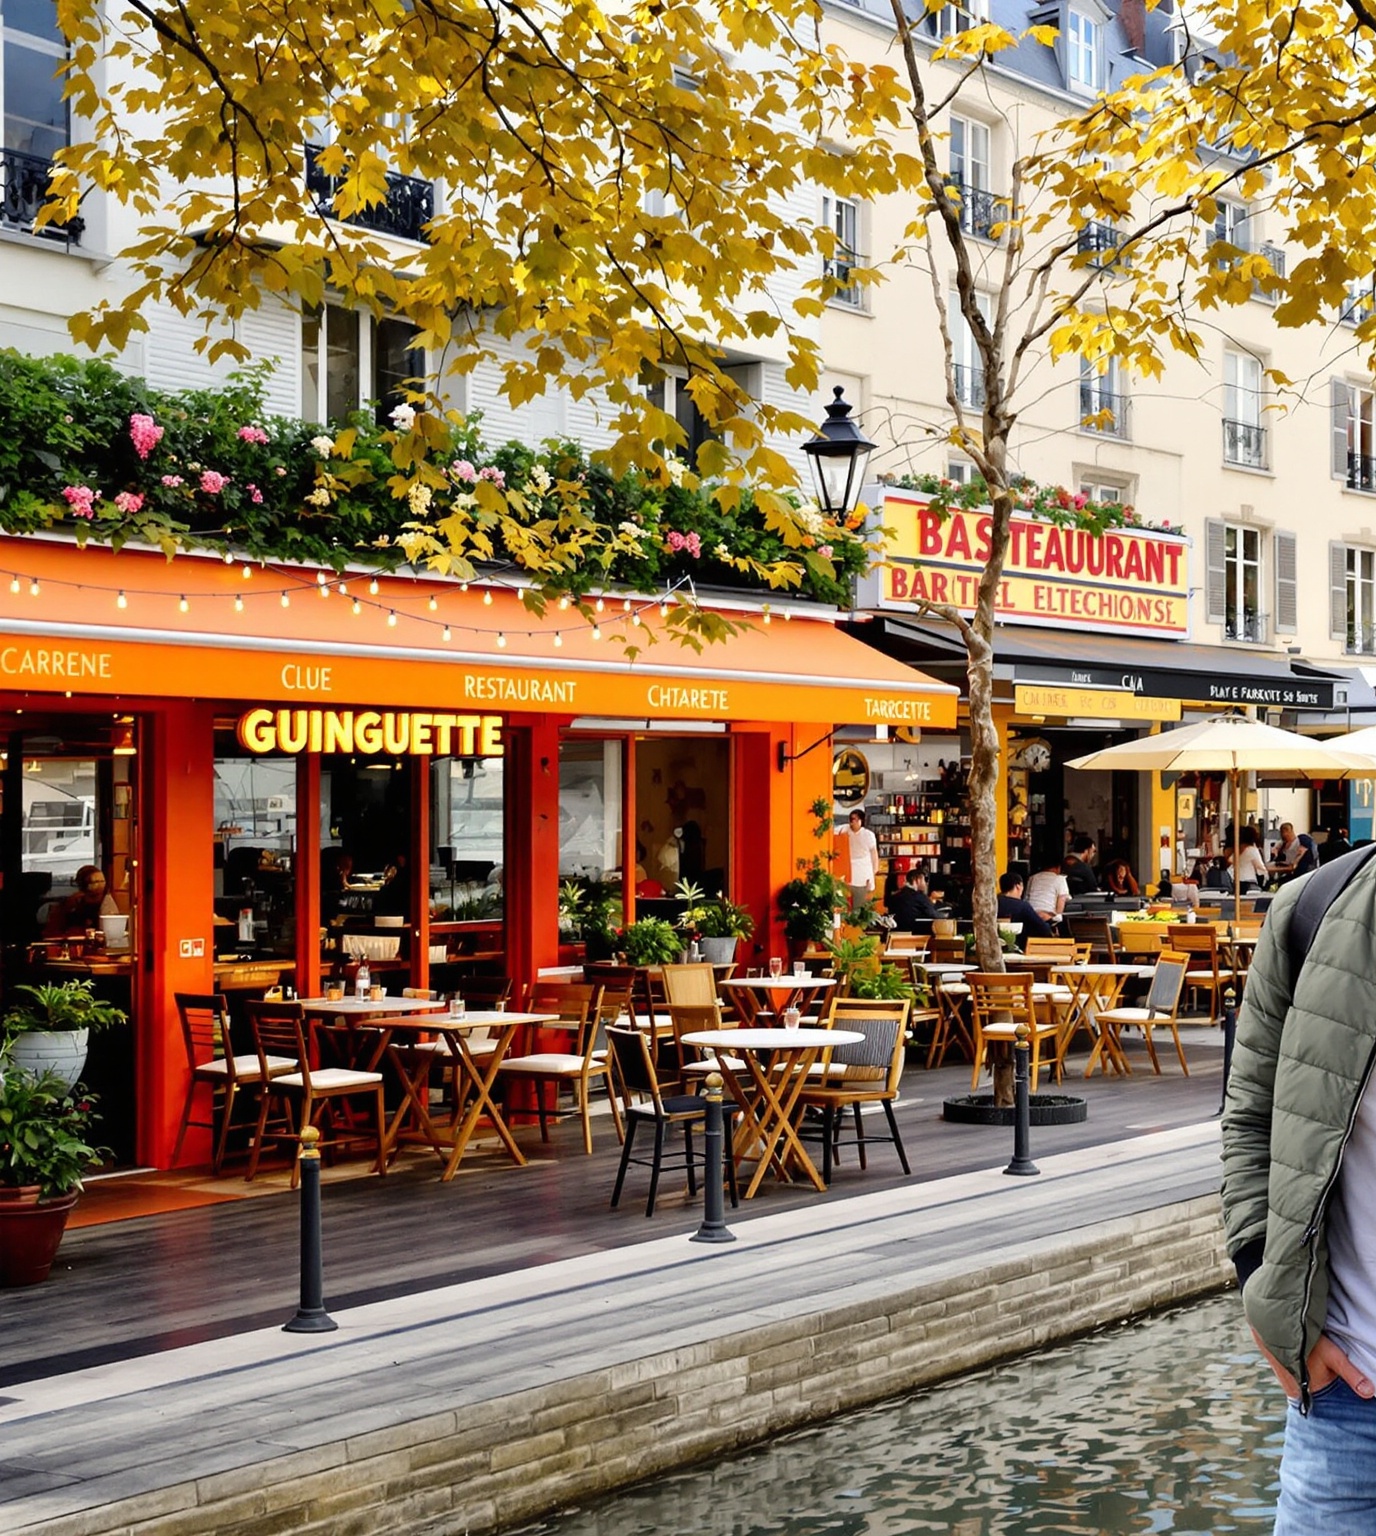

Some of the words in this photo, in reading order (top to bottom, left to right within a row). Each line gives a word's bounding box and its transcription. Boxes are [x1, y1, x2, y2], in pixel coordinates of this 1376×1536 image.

[0, 647, 112, 679] CARRENE
[281, 663, 332, 691] CLUE
[464, 675, 577, 703] RESTAURANT
[238, 706, 504, 756] GUINGUETTE
